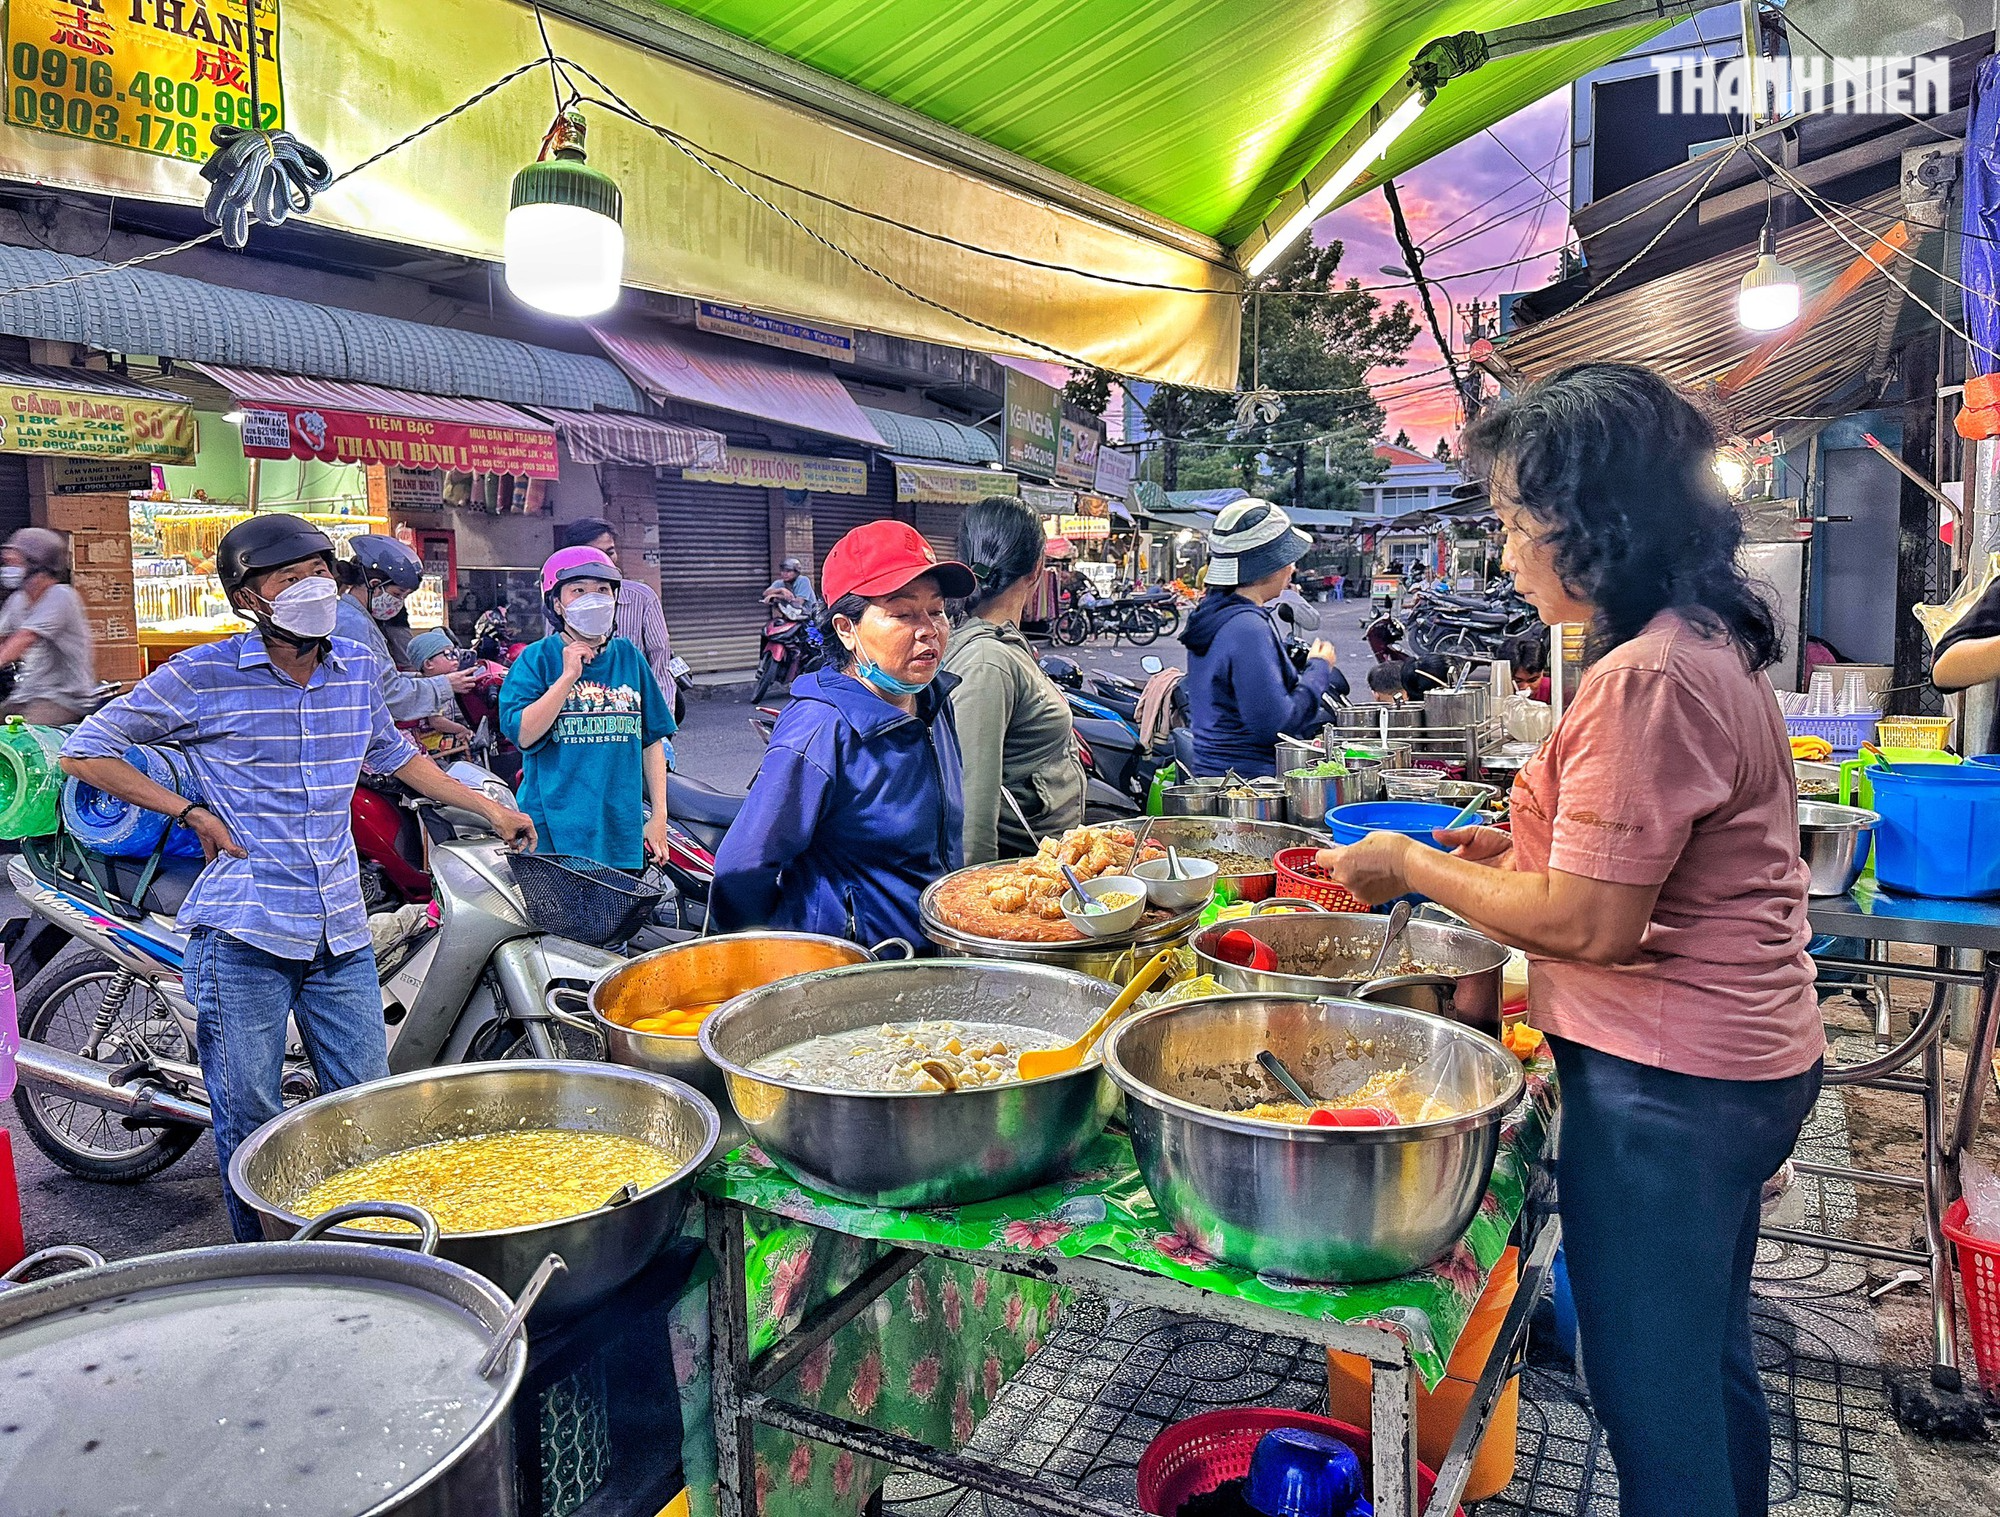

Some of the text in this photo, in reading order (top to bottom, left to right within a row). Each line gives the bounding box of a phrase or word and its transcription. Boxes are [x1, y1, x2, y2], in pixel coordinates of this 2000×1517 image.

[190, 48, 252, 93] 成
[12, 42, 279, 130] 0916.480.992
[11, 392, 125, 421] CẦM VÀNG
[15, 414, 60, 426] 18K
[84, 420, 125, 432] 24K
[169, 414, 185, 441] 7
[366, 415, 435, 436] TIỆM BẠC
[469, 428, 487, 440] MUA
[91, 432, 131, 444] THẤP
[333, 435, 405, 460] THANH
[408, 438, 456, 465] BÌNH
[562, 734, 629, 744] TENNESSEE
